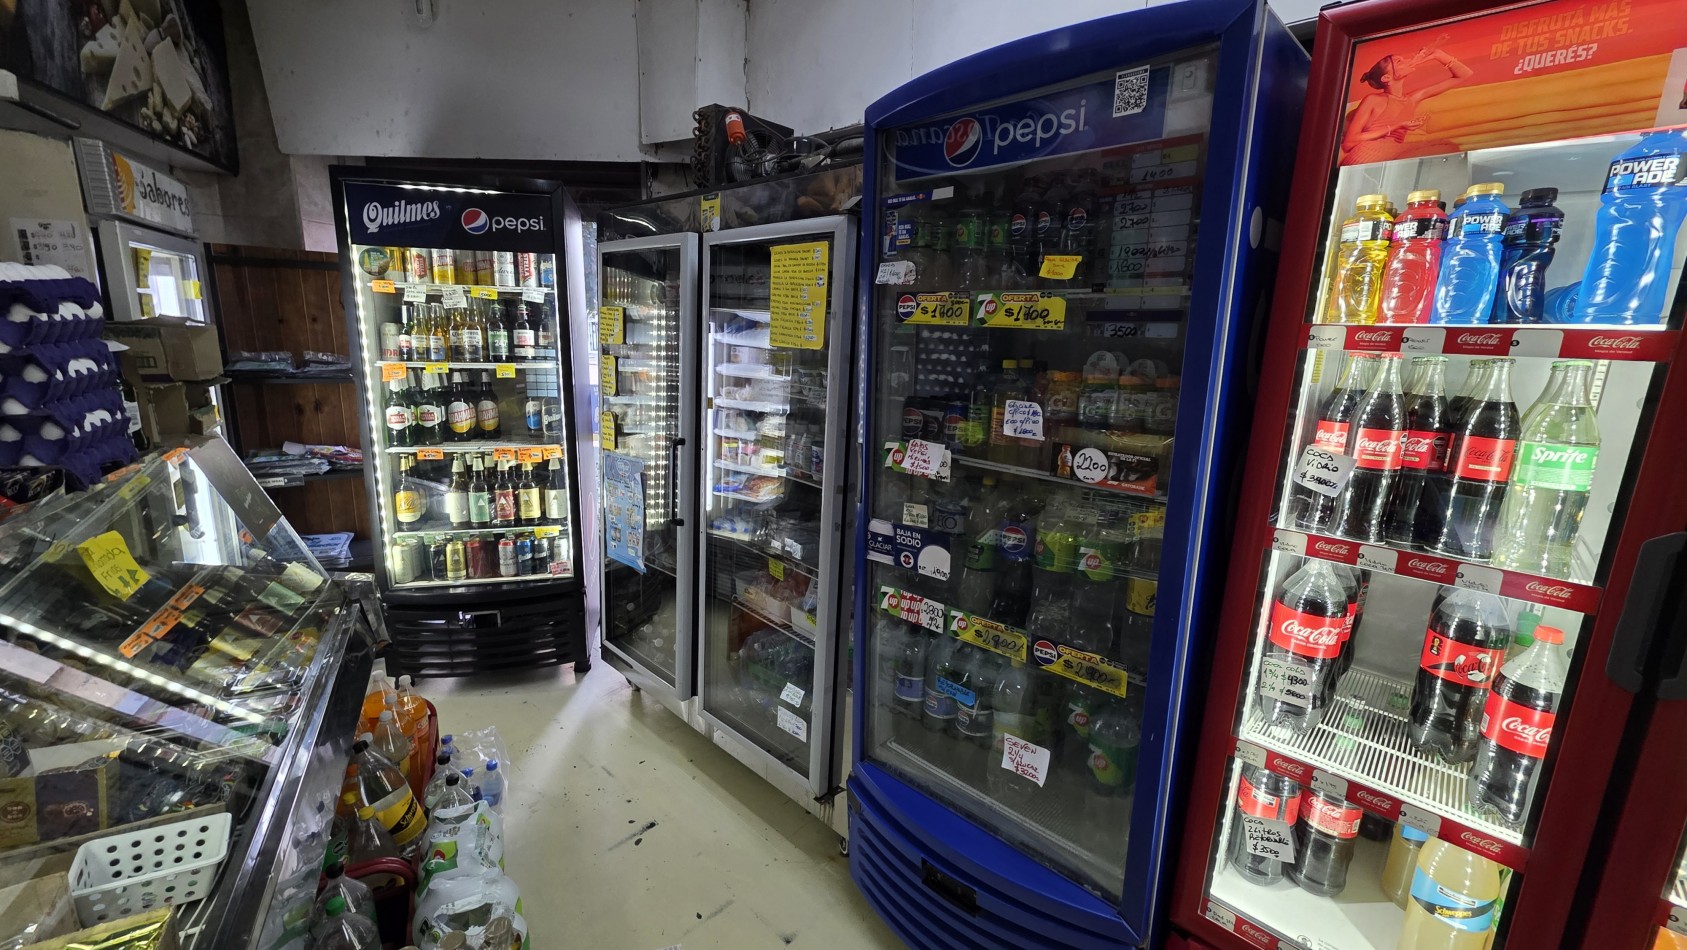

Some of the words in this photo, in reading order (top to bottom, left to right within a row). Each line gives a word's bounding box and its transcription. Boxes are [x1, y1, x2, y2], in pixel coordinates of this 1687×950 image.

[1500, 4, 1585, 41] DISFRUTÁ
[1590, 0, 1632, 22] MÁS
[1490, 41, 1512, 60] DE
[1517, 33, 1550, 55] TUS
[1555, 17, 1633, 48] SNACKS.
[1514, 43, 1598, 75] ¿QUERÉS?
[994, 99, 1088, 155] pepsi
[1610, 158, 1680, 177] POWER
[1632, 170, 1677, 186] ADE
[363, 200, 440, 234] Quilmes
[492, 216, 547, 233] pepsi
[1463, 215, 1503, 224] POWER
[1480, 223, 1502, 232] ADE
[1002, 294, 1038, 302] OFERTA
[1110, 324, 1137, 336] 3500
[1354, 330, 1393, 342] Coca-Cola
[1457, 332, 1502, 345] Coca-Cola
[1588, 336, 1646, 349] Coca-Cola
[1358, 438, 1397, 452] Coca-Cola
[1466, 447, 1509, 463] Coca-Cola
[1531, 447, 1588, 463] Sprite
[896, 528, 911, 537] BAJA
[896, 535, 921, 548] SODIO
[1315, 540, 1350, 554] Coca-Cola
[1408, 559, 1449, 574] Coca-Cola
[1526, 581, 1574, 599] Coca-Cola
[971, 617, 1003, 631] OFERTA
[1281, 620, 1340, 645] Coca-Cola
[1035, 647, 1056, 658] PEPSI
[1059, 646, 1099, 665] OFERTA
[1502, 717, 1552, 742] Coca-C
[1356, 791, 1394, 809] Coca-Cola
[1460, 832, 1504, 853] Coca-Cola
[1435, 906, 1472, 918] Schweppes
